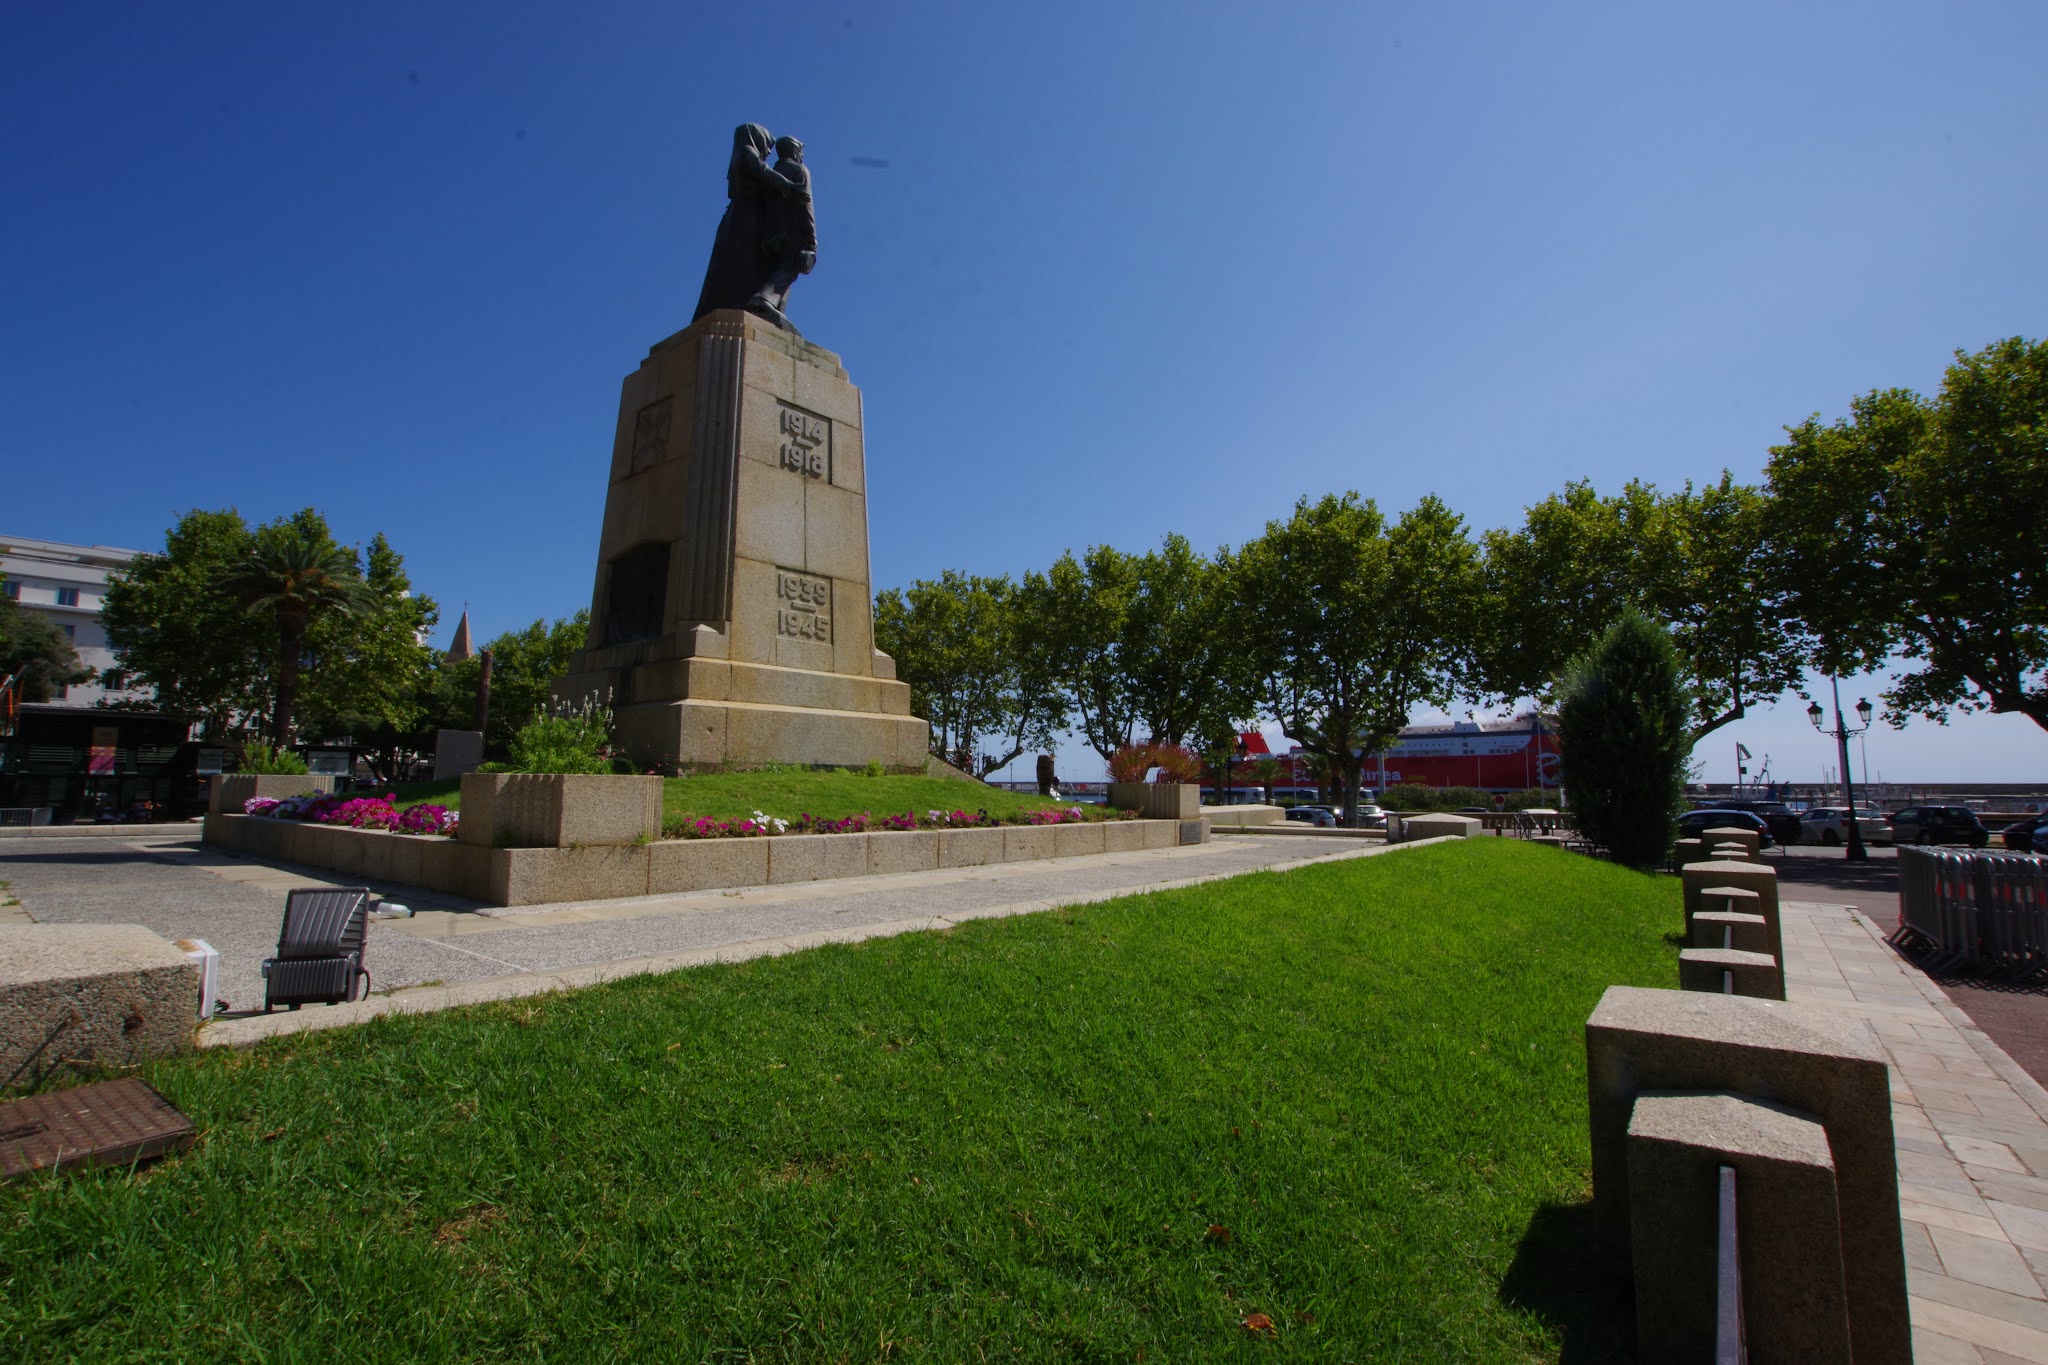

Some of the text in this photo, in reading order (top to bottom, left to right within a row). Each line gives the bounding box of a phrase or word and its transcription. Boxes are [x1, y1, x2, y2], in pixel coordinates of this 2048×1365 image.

[781, 408, 825, 444] 1914
[781, 443, 825, 477] 1918
[778, 573, 827, 605] 1939
[778, 609, 829, 641] 1945
